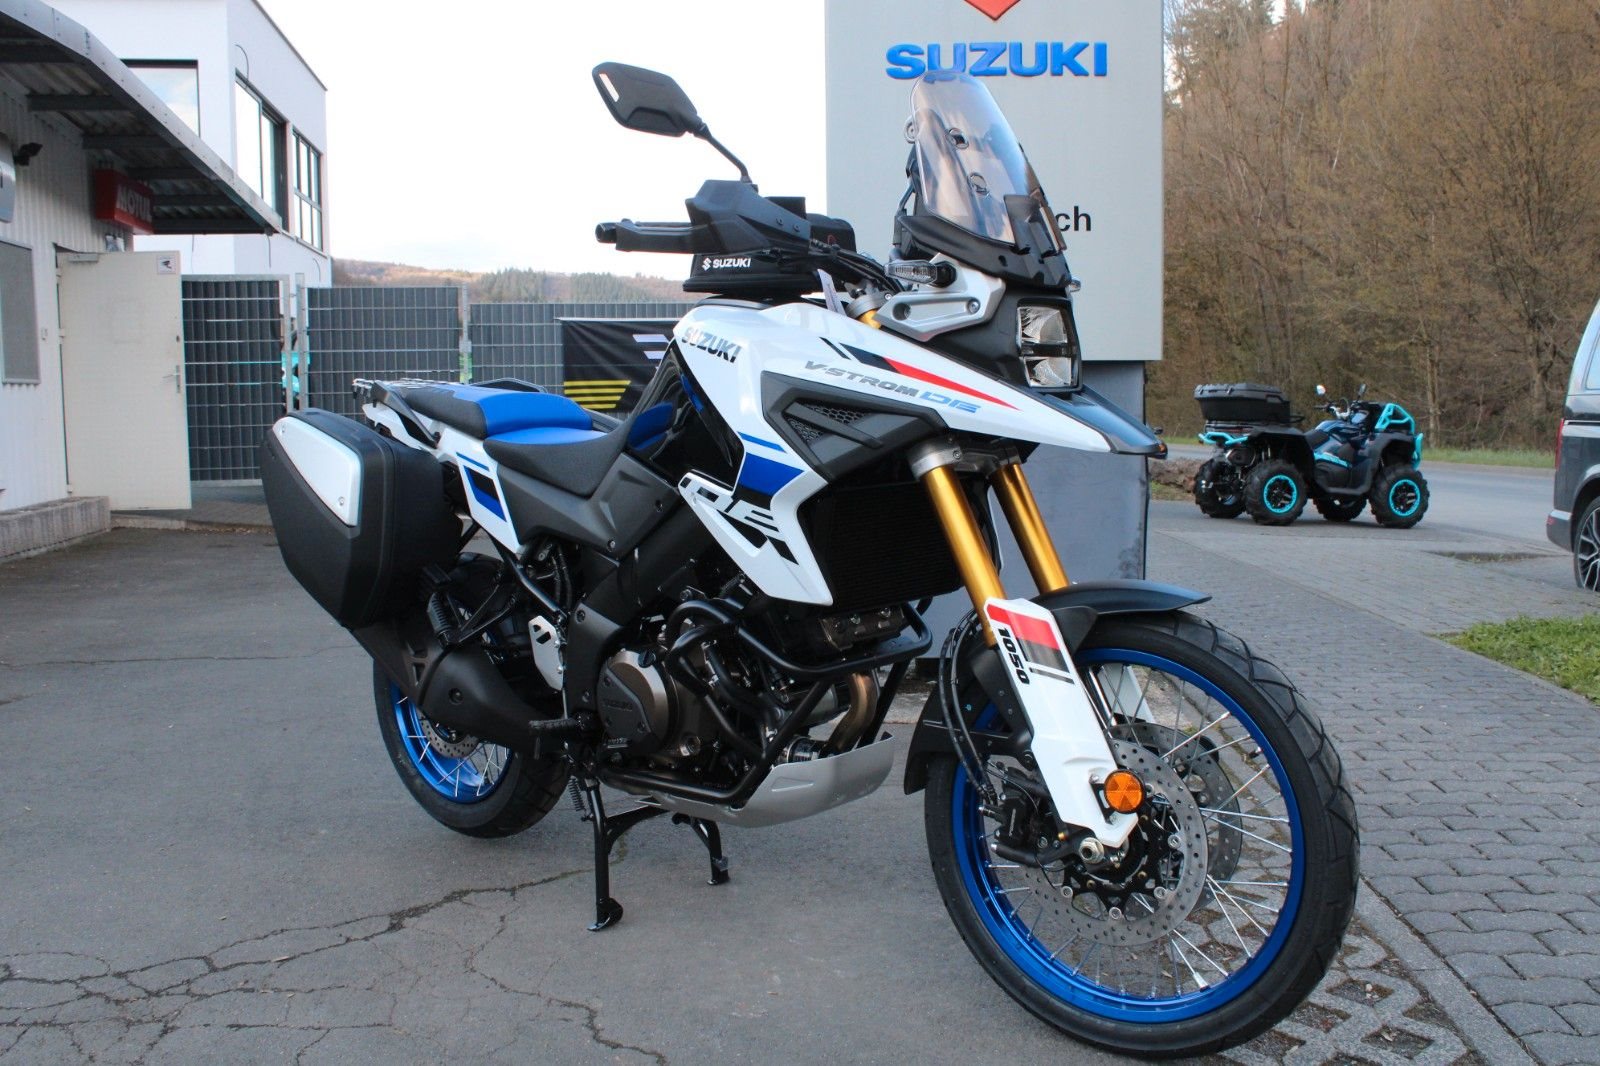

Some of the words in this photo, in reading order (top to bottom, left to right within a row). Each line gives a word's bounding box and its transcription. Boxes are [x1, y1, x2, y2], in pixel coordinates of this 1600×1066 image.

[886, 41, 1107, 79] SUZUKI
[1055, 205, 1091, 231] ch
[712, 257, 752, 269] SUZUKI
[681, 327, 743, 363] SUZUKI
[998, 627, 1030, 685] 1050
